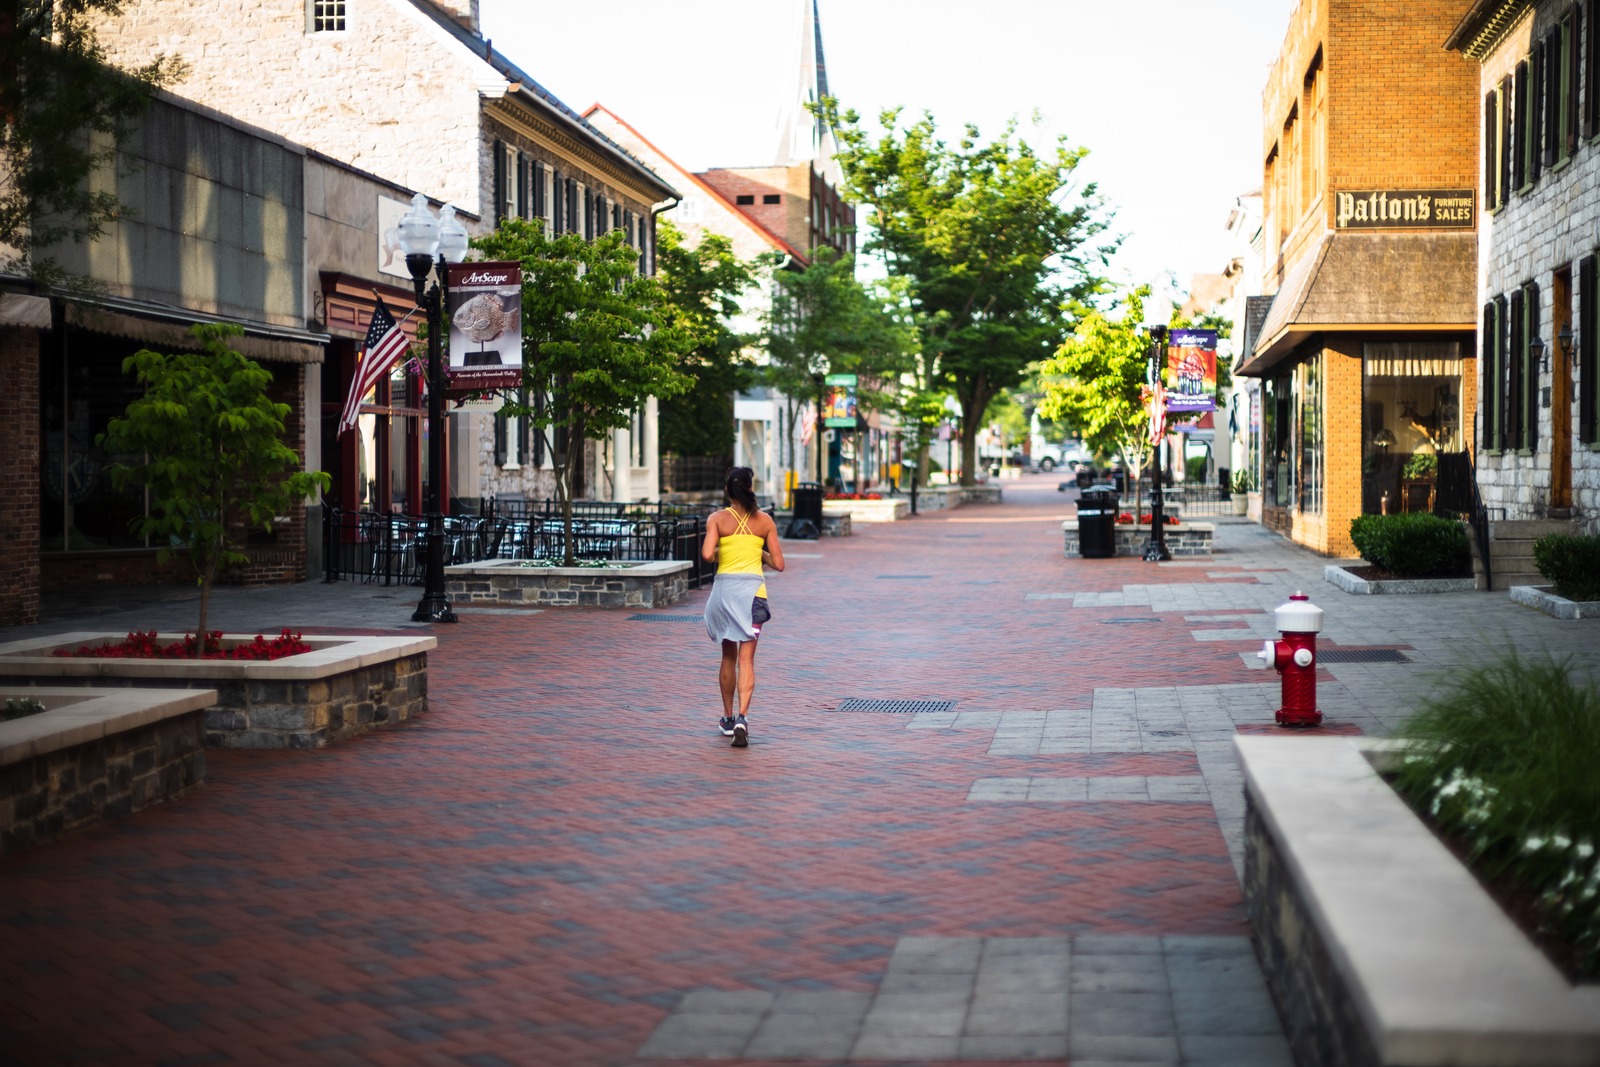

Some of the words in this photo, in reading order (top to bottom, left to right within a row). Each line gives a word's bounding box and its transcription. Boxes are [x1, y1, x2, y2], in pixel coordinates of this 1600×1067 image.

[1434, 198, 1473, 208] FURNITURE
[1337, 192, 1431, 228] Patton's
[1435, 208, 1471, 221] SALES
[462, 272, 508, 284] ArtScape
